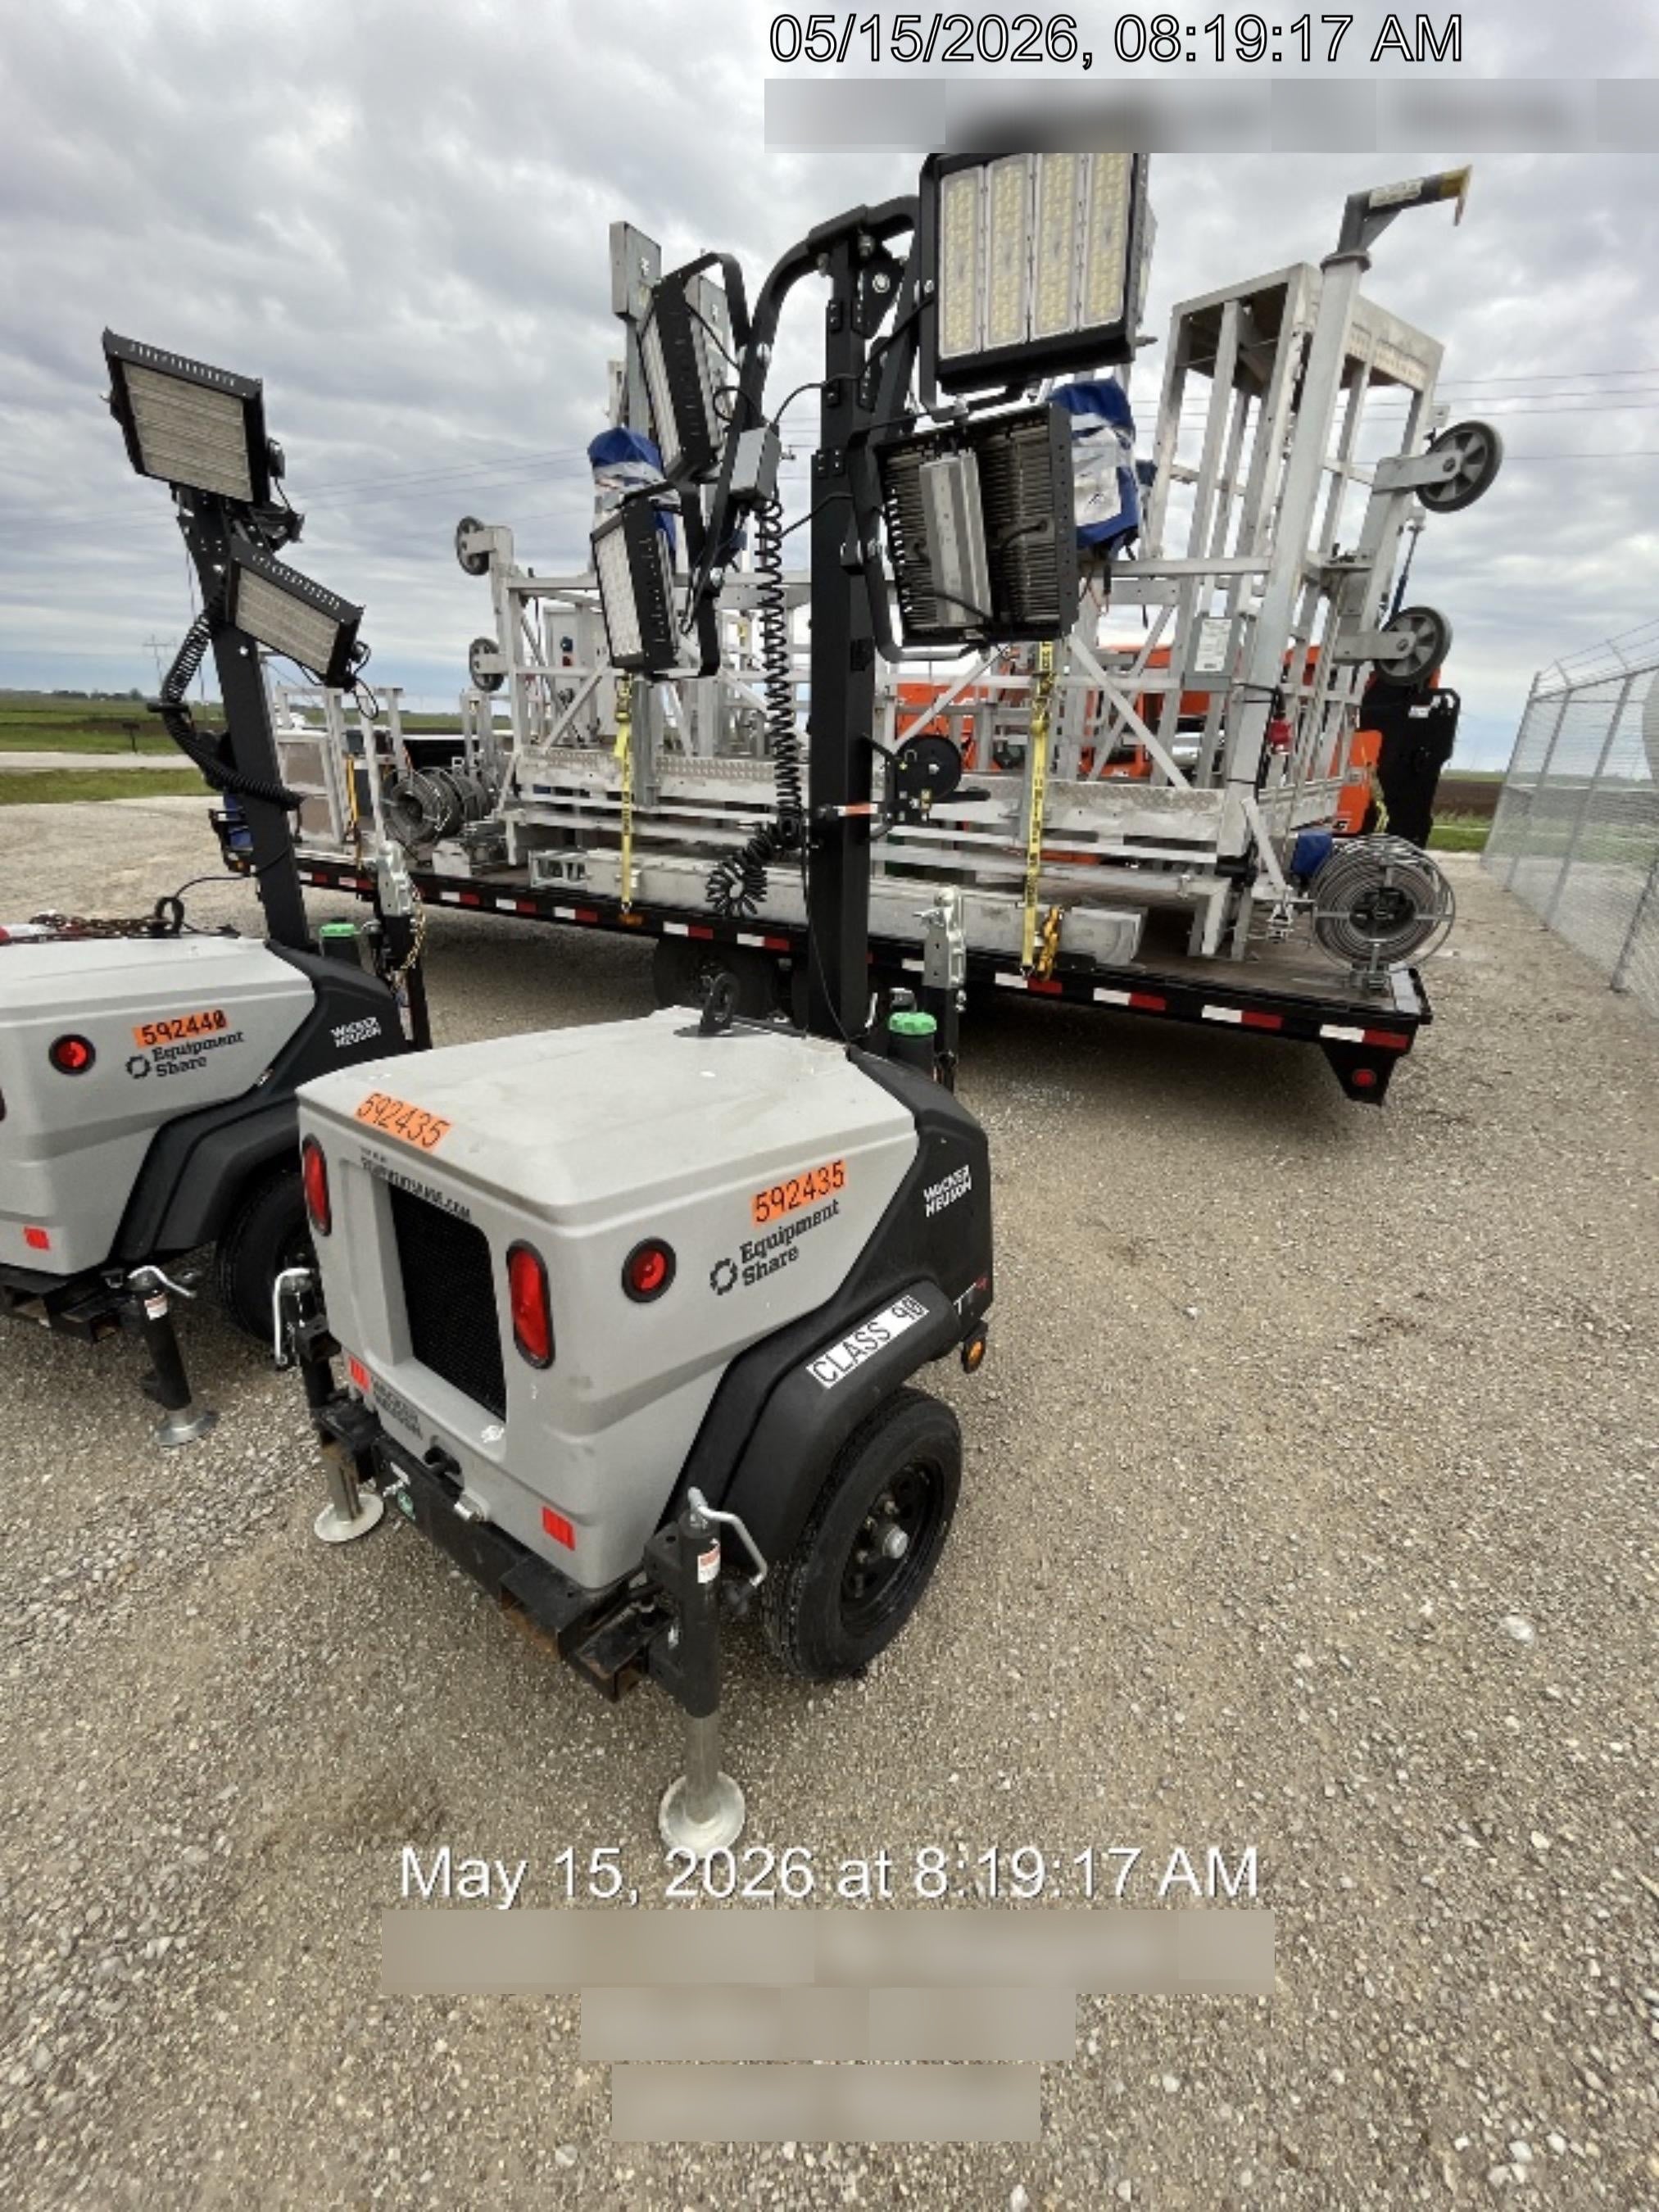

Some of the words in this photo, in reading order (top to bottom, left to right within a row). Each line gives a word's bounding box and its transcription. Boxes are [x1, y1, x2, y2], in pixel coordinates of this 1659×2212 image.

[152, 1031, 244, 1062] Equipment
[156, 1057, 207, 1077] Share
[356, 1092, 451, 1148] 592435
[755, 1158, 845, 1222] 592435
[926, 1175, 972, 1217] NEUSON
[739, 1199, 840, 1263] Equipment
[741, 1245, 800, 1286] Share
[813, 1321, 891, 1382] CLASS
